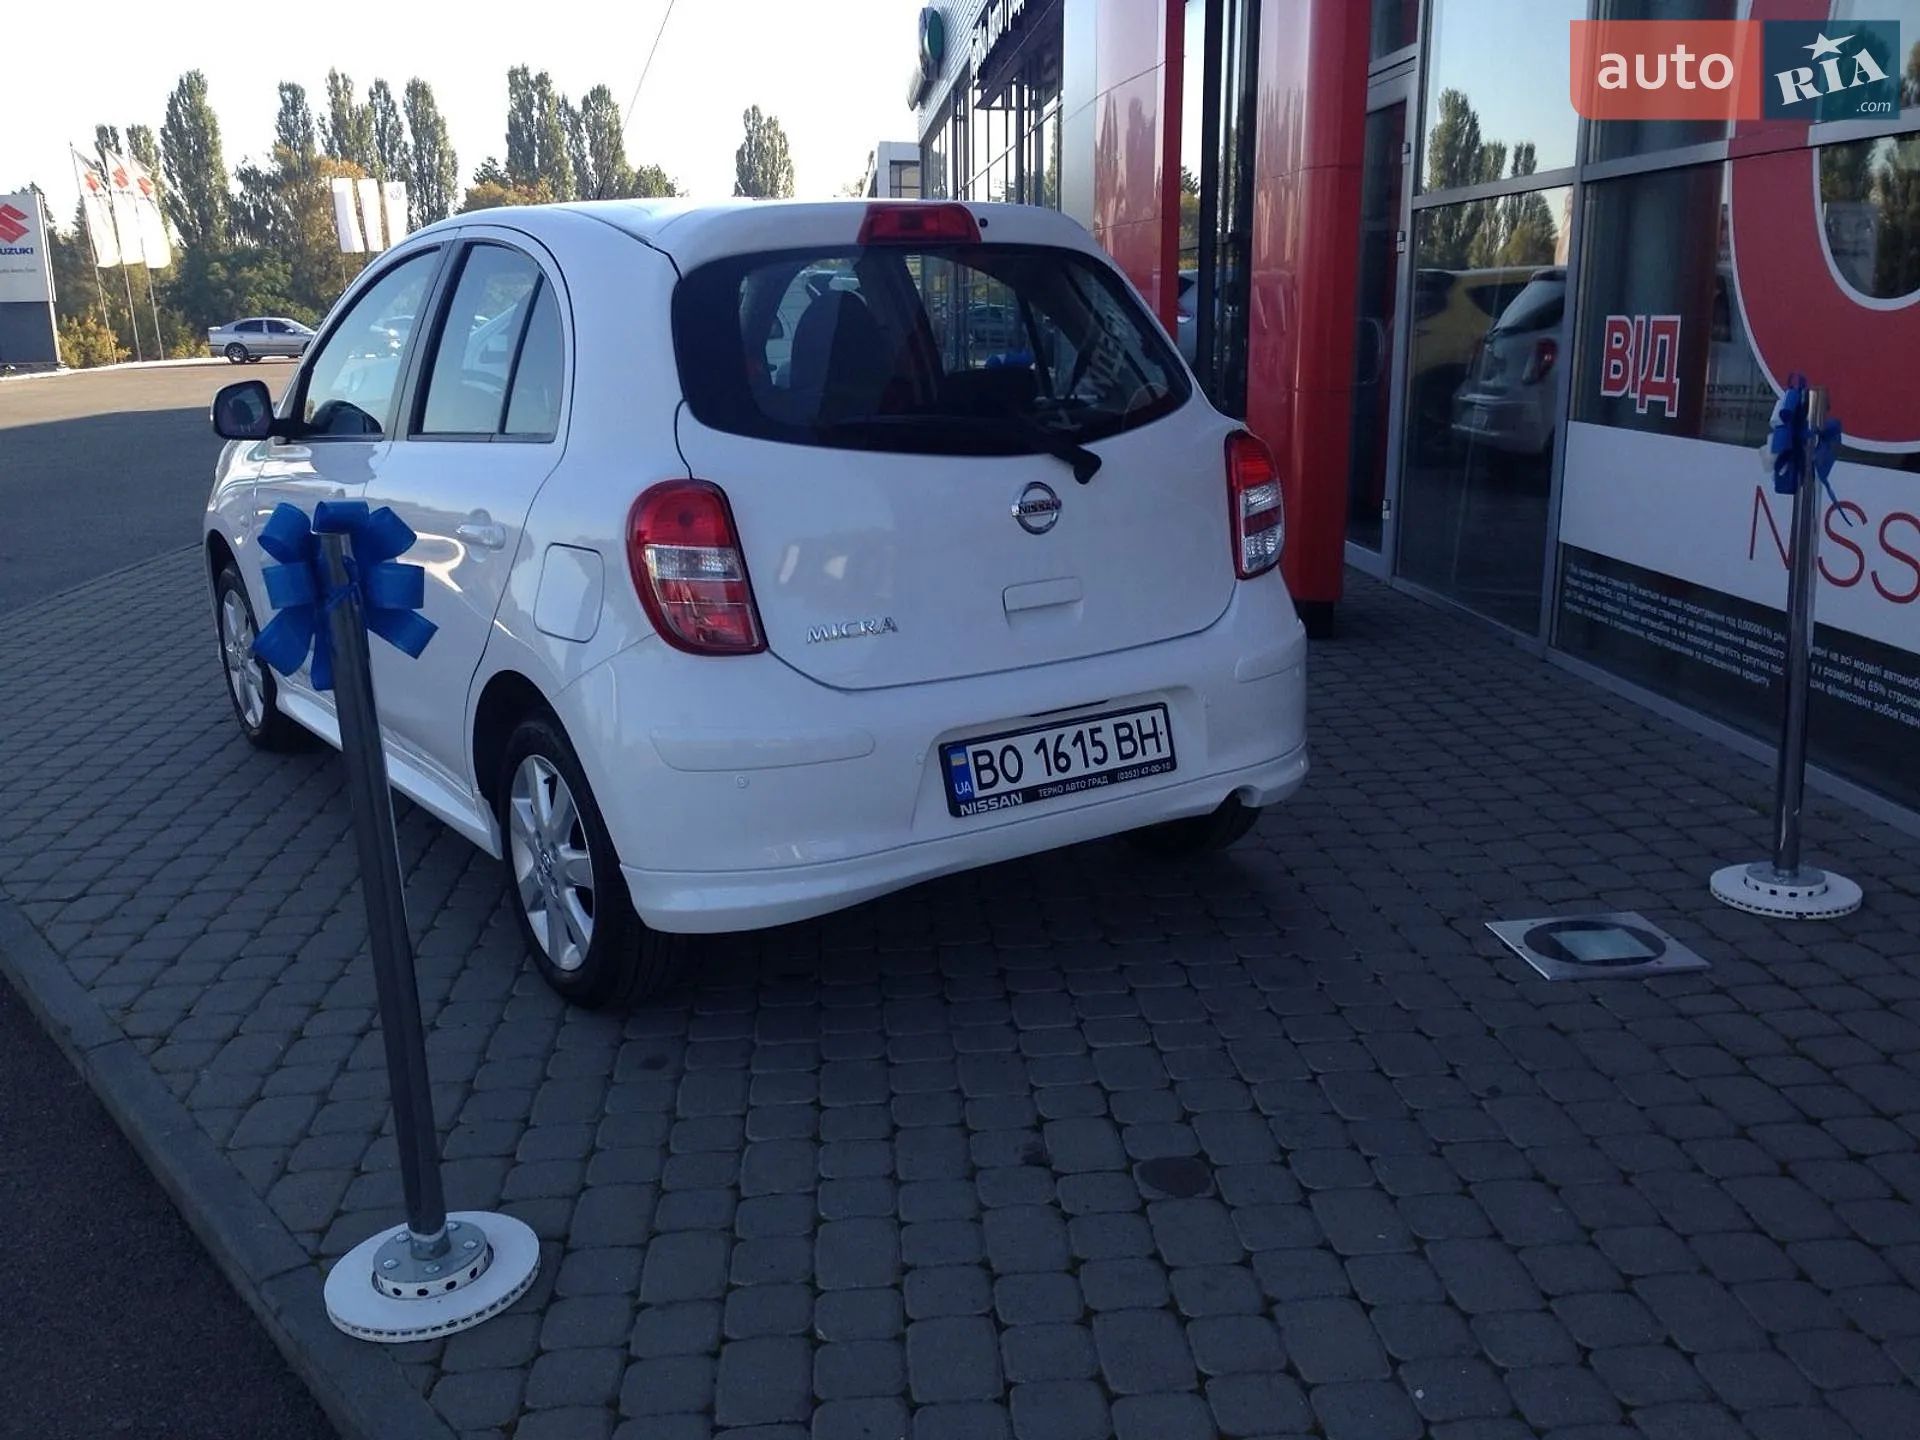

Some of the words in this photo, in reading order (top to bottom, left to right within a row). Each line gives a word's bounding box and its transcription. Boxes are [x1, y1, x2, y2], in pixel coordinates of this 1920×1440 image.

[1600, 314, 1682, 418] ВІД
[1018, 499, 1057, 514] NISSAN
[1749, 485, 1920, 604] NSS
[807, 617, 898, 645] MICRA
[1883, 669, 1920, 690] автомоб
[1888, 690, 1920, 709] строко
[972, 744, 1024, 791] BO
[1034, 727, 1108, 777] 1615
[1113, 715, 1161, 761] BH
[954, 782, 972, 796] UA
[1065, 780, 1087, 793] АВТО
[1087, 775, 1108, 788] ГРАД
[959, 792, 1023, 816] NISSAN
